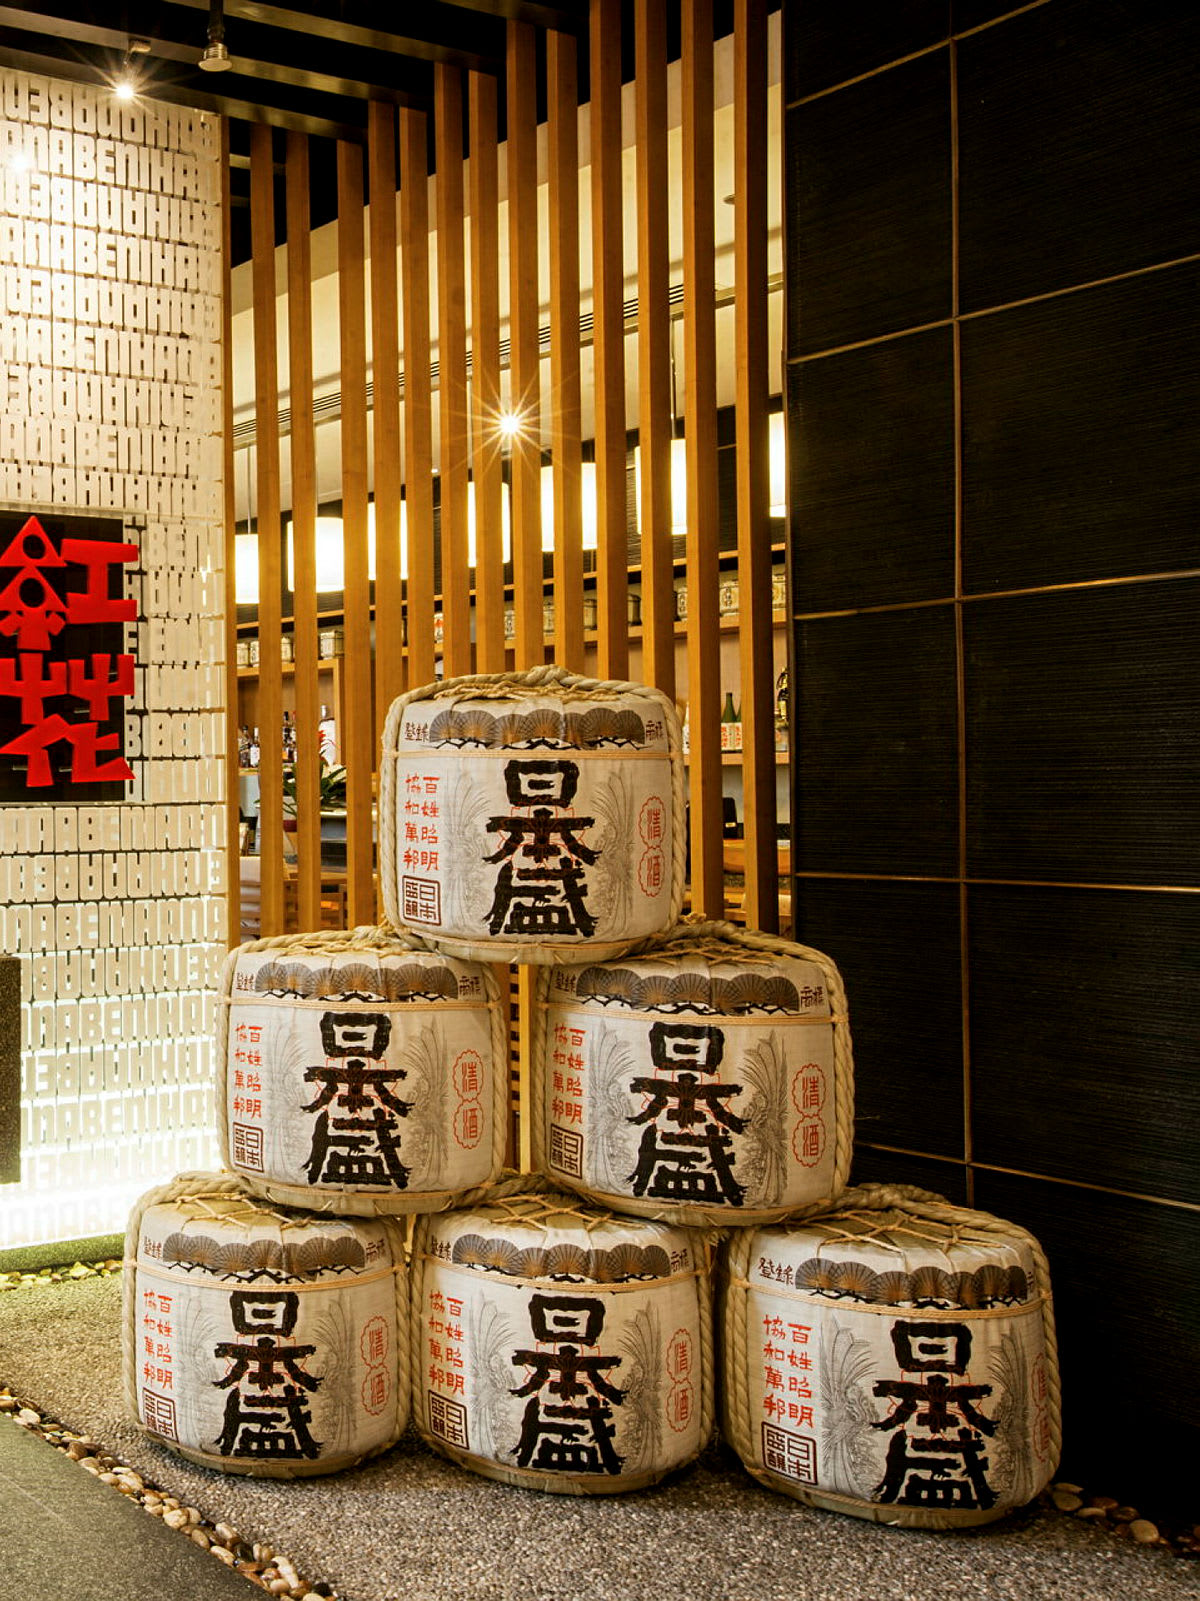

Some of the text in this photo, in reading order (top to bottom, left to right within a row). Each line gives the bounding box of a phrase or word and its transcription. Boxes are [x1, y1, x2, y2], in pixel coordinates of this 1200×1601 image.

[483, 759, 603, 938] 日本盛
[301, 1011, 415, 1190] 日本盛
[461, 1061, 478, 1140] 清酒
[624, 1021, 753, 1207] 日本盛
[801, 1075, 820, 1157] 清酒
[211, 1290, 325, 1460] 日本盛
[509, 1293, 630, 1476] 日本盛
[786, 1321, 815, 1429] 百姓昭明
[868, 1320, 1002, 1512] 日本盛
